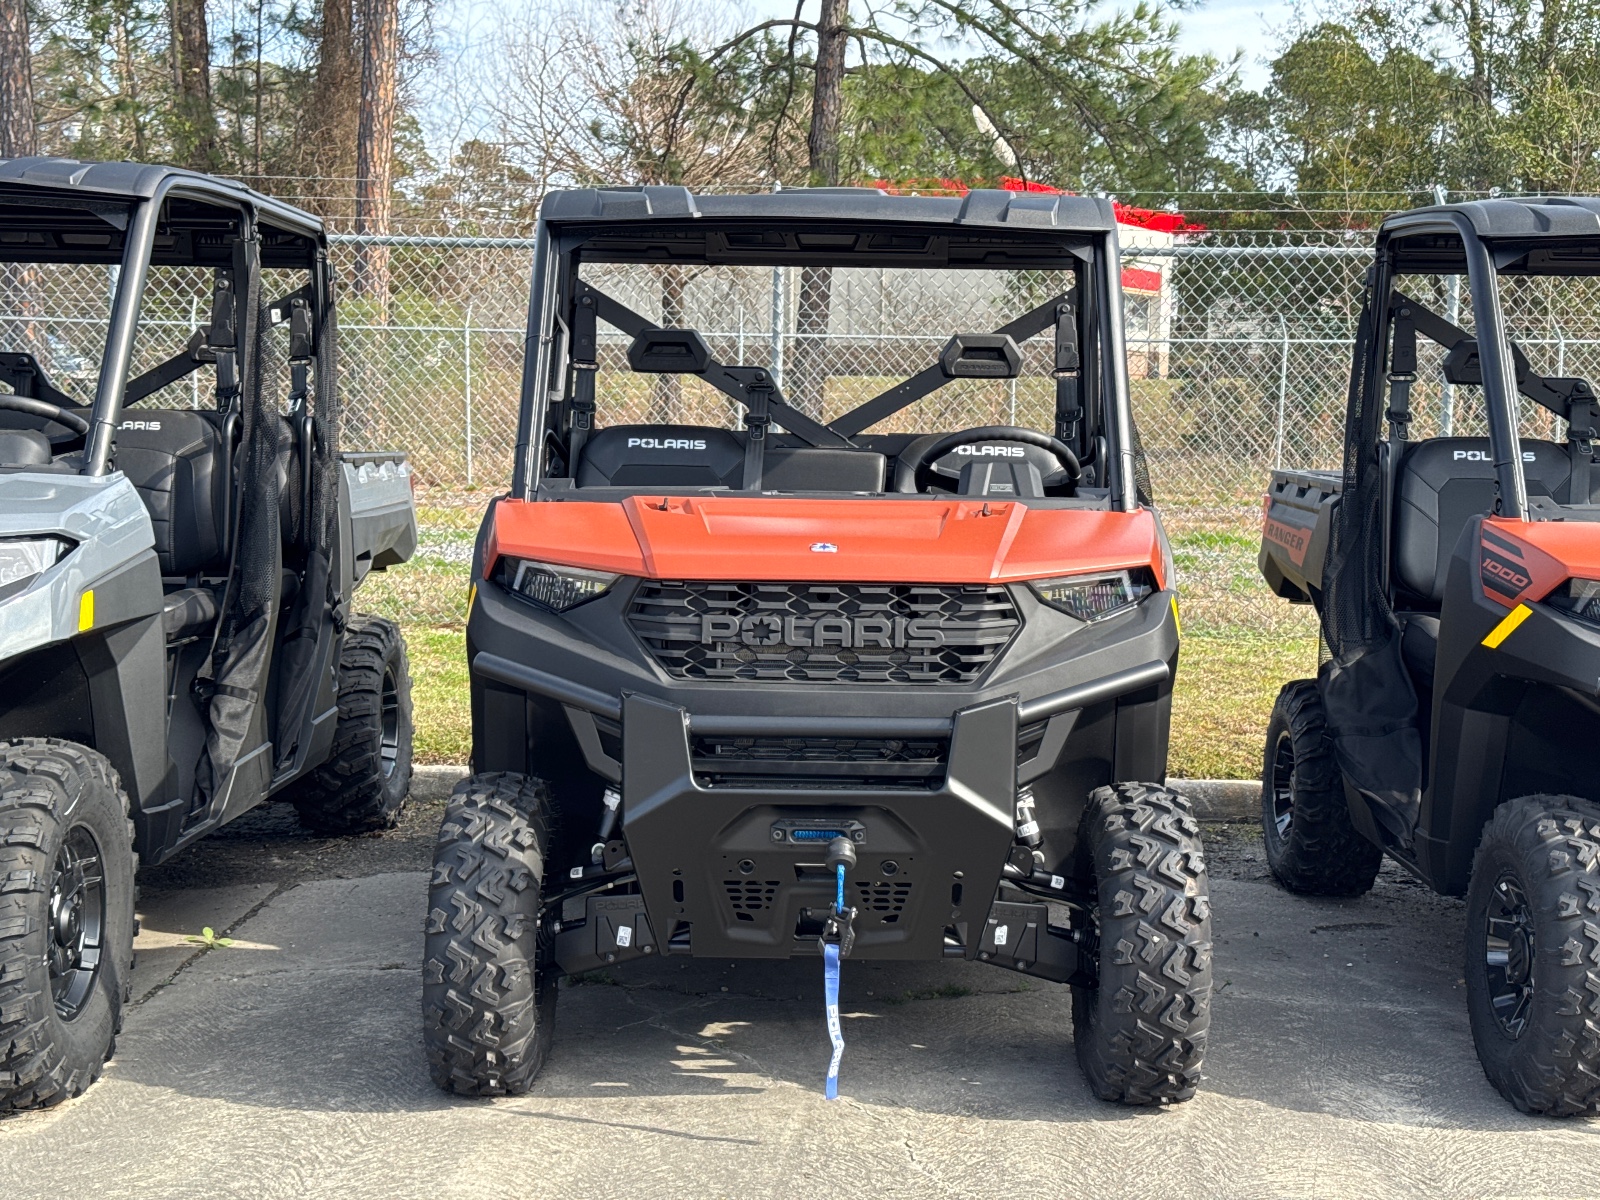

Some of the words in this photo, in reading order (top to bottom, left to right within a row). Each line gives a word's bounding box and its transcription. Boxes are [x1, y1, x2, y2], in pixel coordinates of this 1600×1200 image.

[117, 421, 161, 430] ARIS
[628, 438, 706, 450] POLARIS
[1454, 451, 1536, 461] POLS
[1268, 524, 1304, 551] RANGER
[1482, 558, 1528, 587] 1000
[702, 615, 945, 648] POLARIS
[828, 1004, 845, 1078] POLARIS
